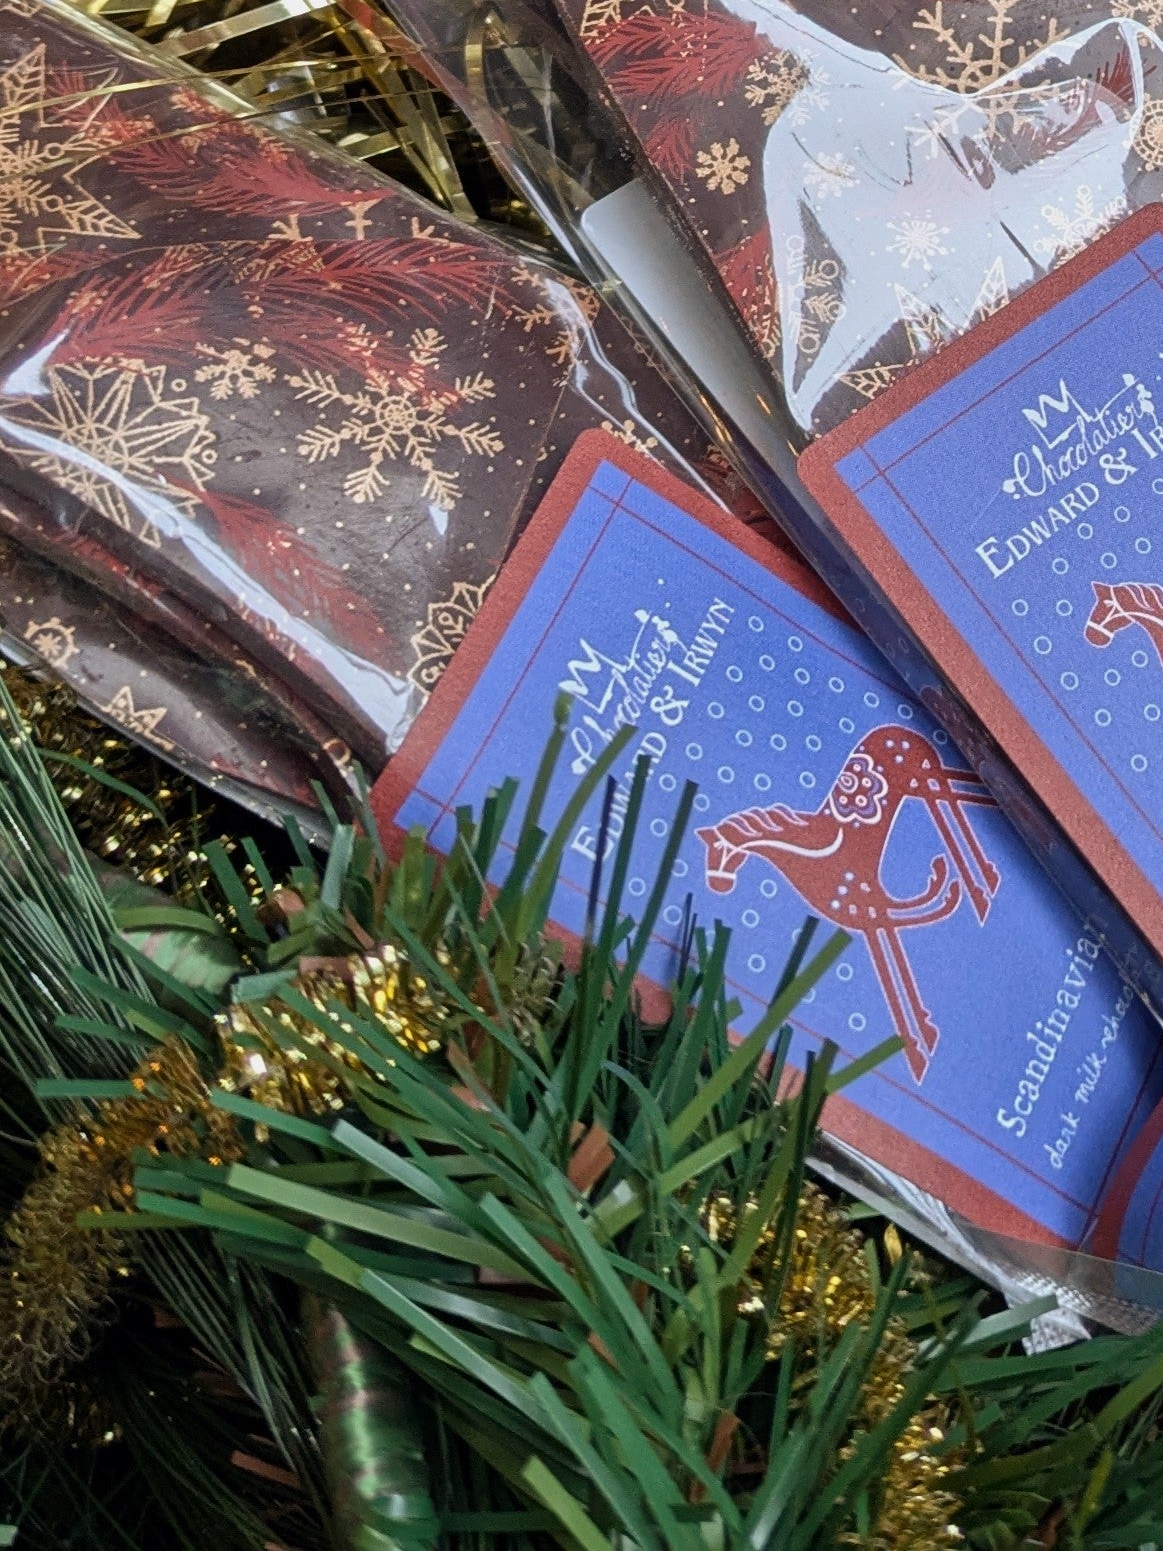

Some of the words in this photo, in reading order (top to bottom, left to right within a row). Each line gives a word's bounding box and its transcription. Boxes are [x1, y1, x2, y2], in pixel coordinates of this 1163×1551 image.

[974, 480, 1100, 579] EDWARD
[1099, 446, 1139, 486] &
[667, 597, 735, 688] IRWYN
[650, 684, 690, 727] &
[1043, 1109, 1081, 1169] dark
[1074, 1051, 1107, 1104] milk
